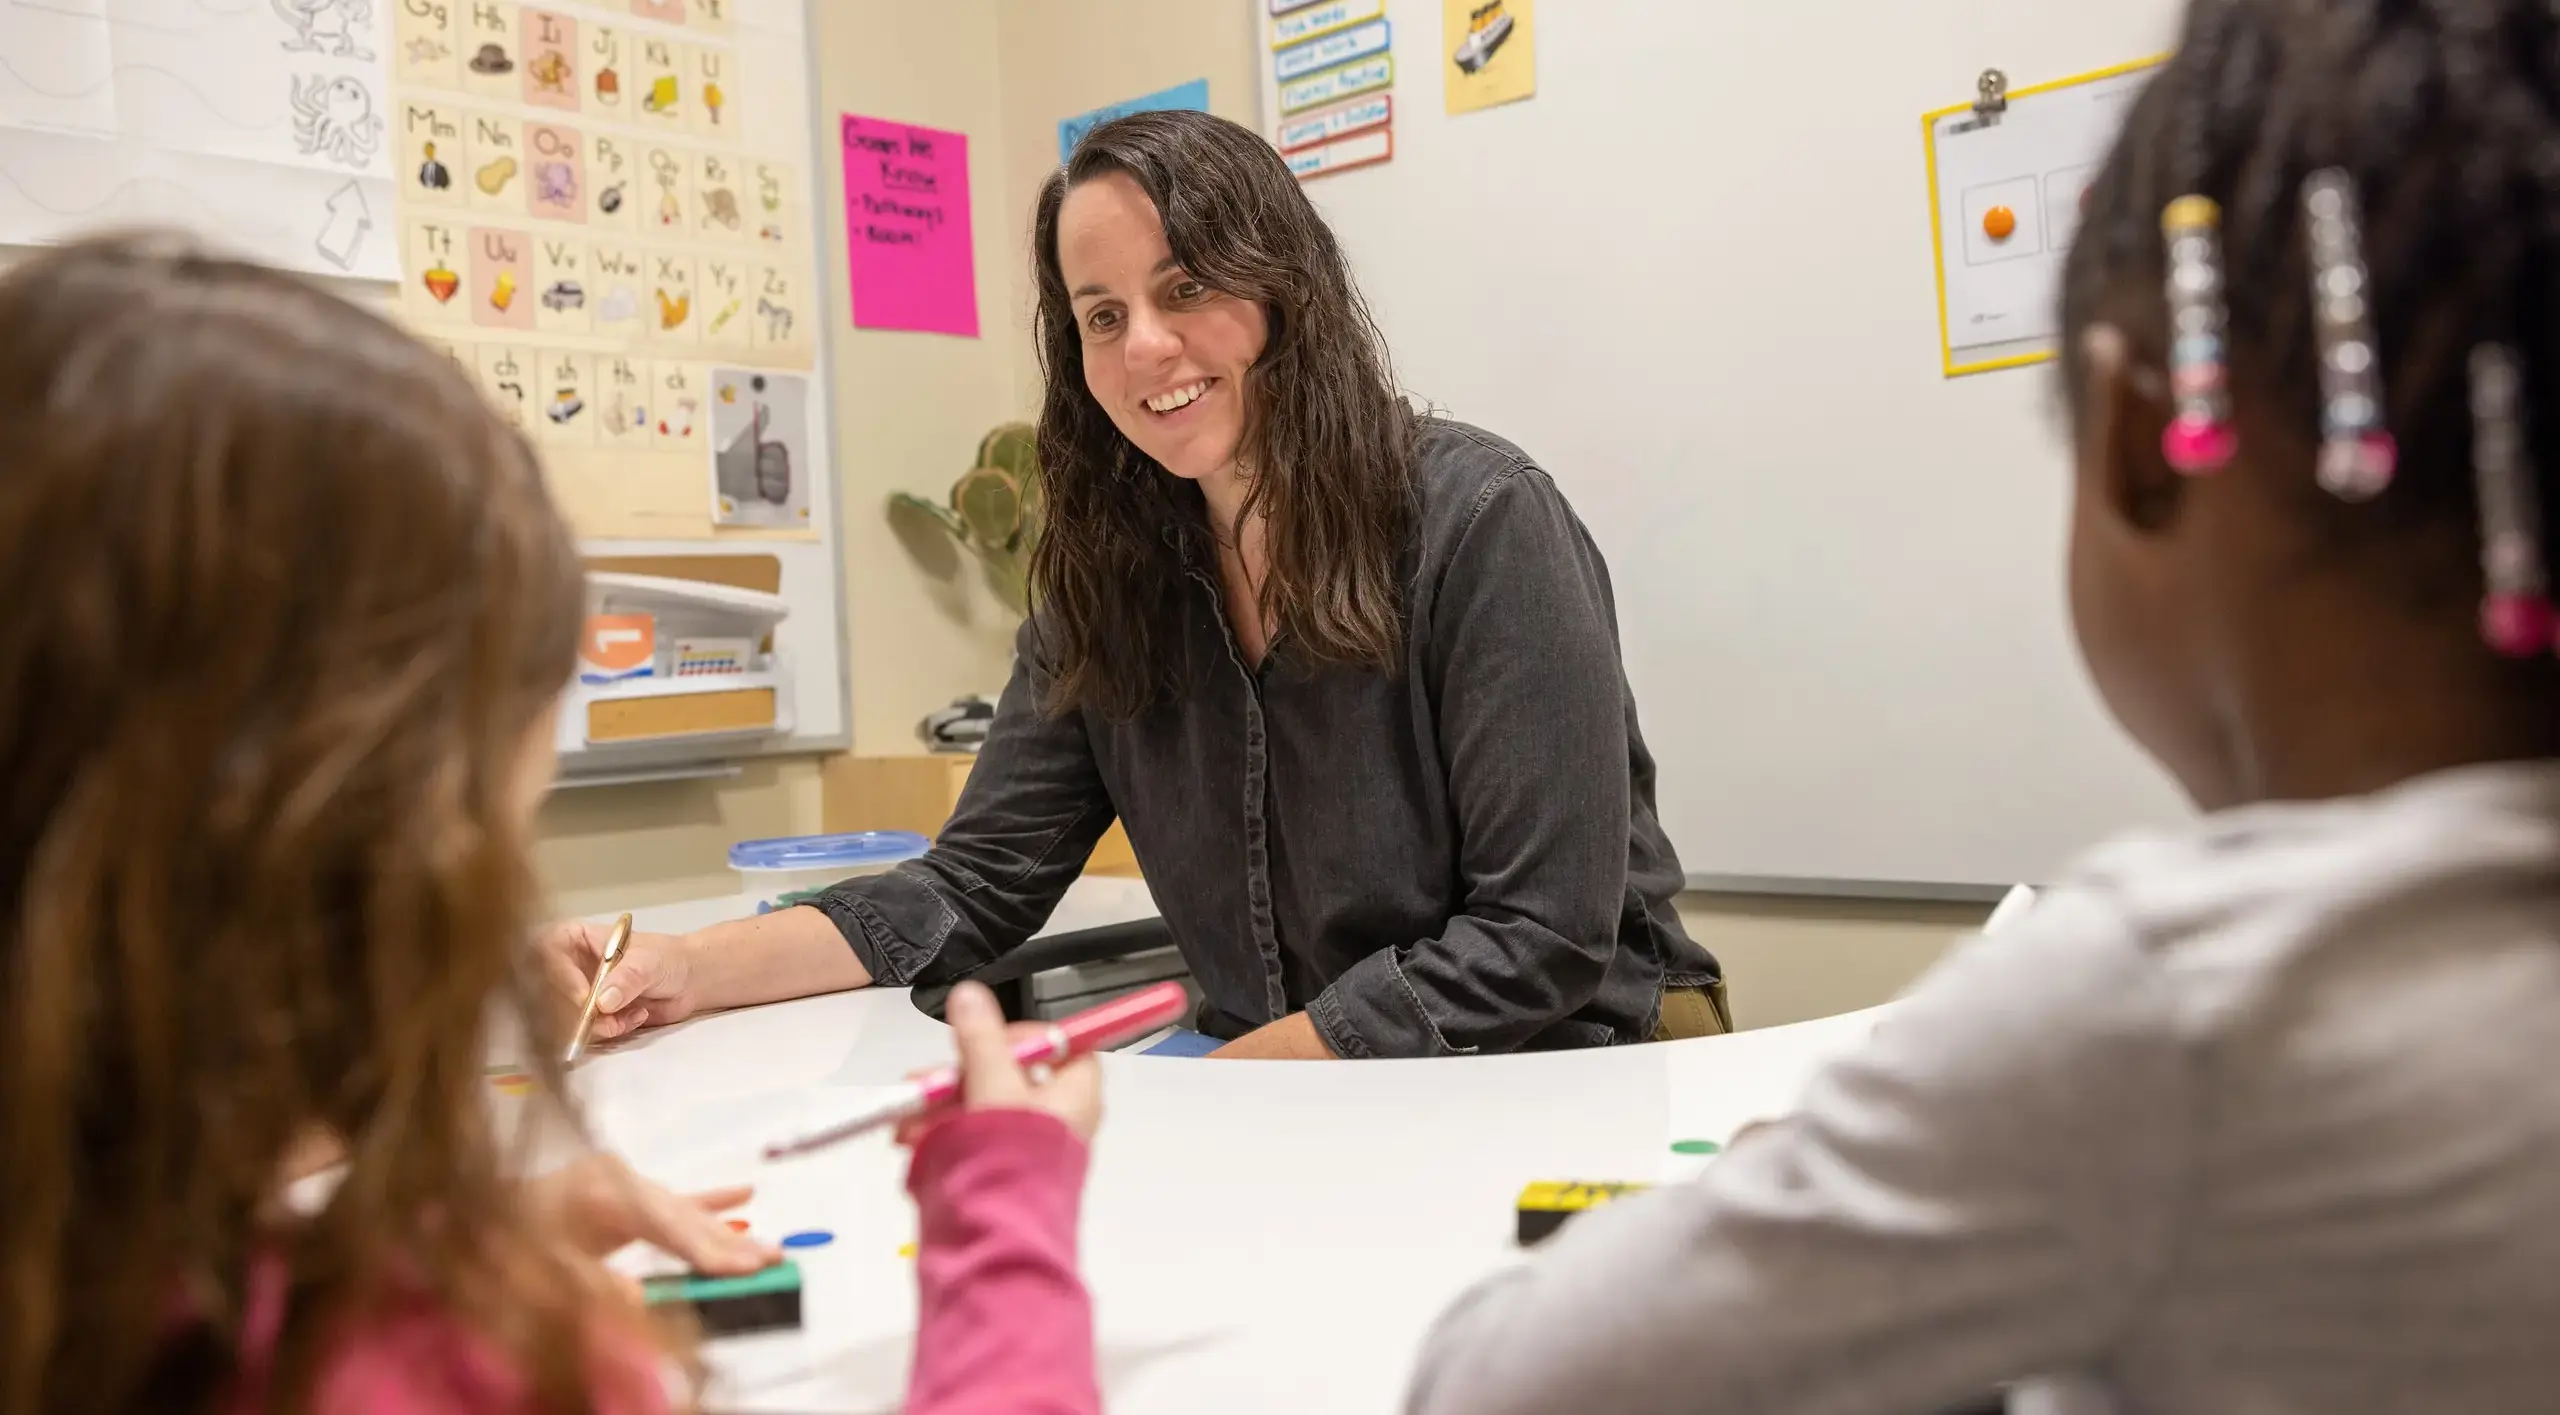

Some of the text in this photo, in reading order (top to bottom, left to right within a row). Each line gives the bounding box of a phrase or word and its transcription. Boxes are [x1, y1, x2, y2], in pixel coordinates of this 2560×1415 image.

[405, 0, 447, 31] Gg
[473, 2, 506, 33] Hh
[592, 28, 617, 66] Jj
[408, 105, 456, 138] Mm
[476, 117, 512, 148] Nn
[533, 127, 574, 158] Oo
[596, 136, 624, 173] Pp
[705, 156, 728, 182] Rr
[422, 225, 788, 296] Tt Uu Vv Ww Xx Yy Zz
[493, 349, 519, 377] ch
[555, 355, 577, 381] sh
[612, 360, 636, 384] th
[665, 366, 686, 390] ck
